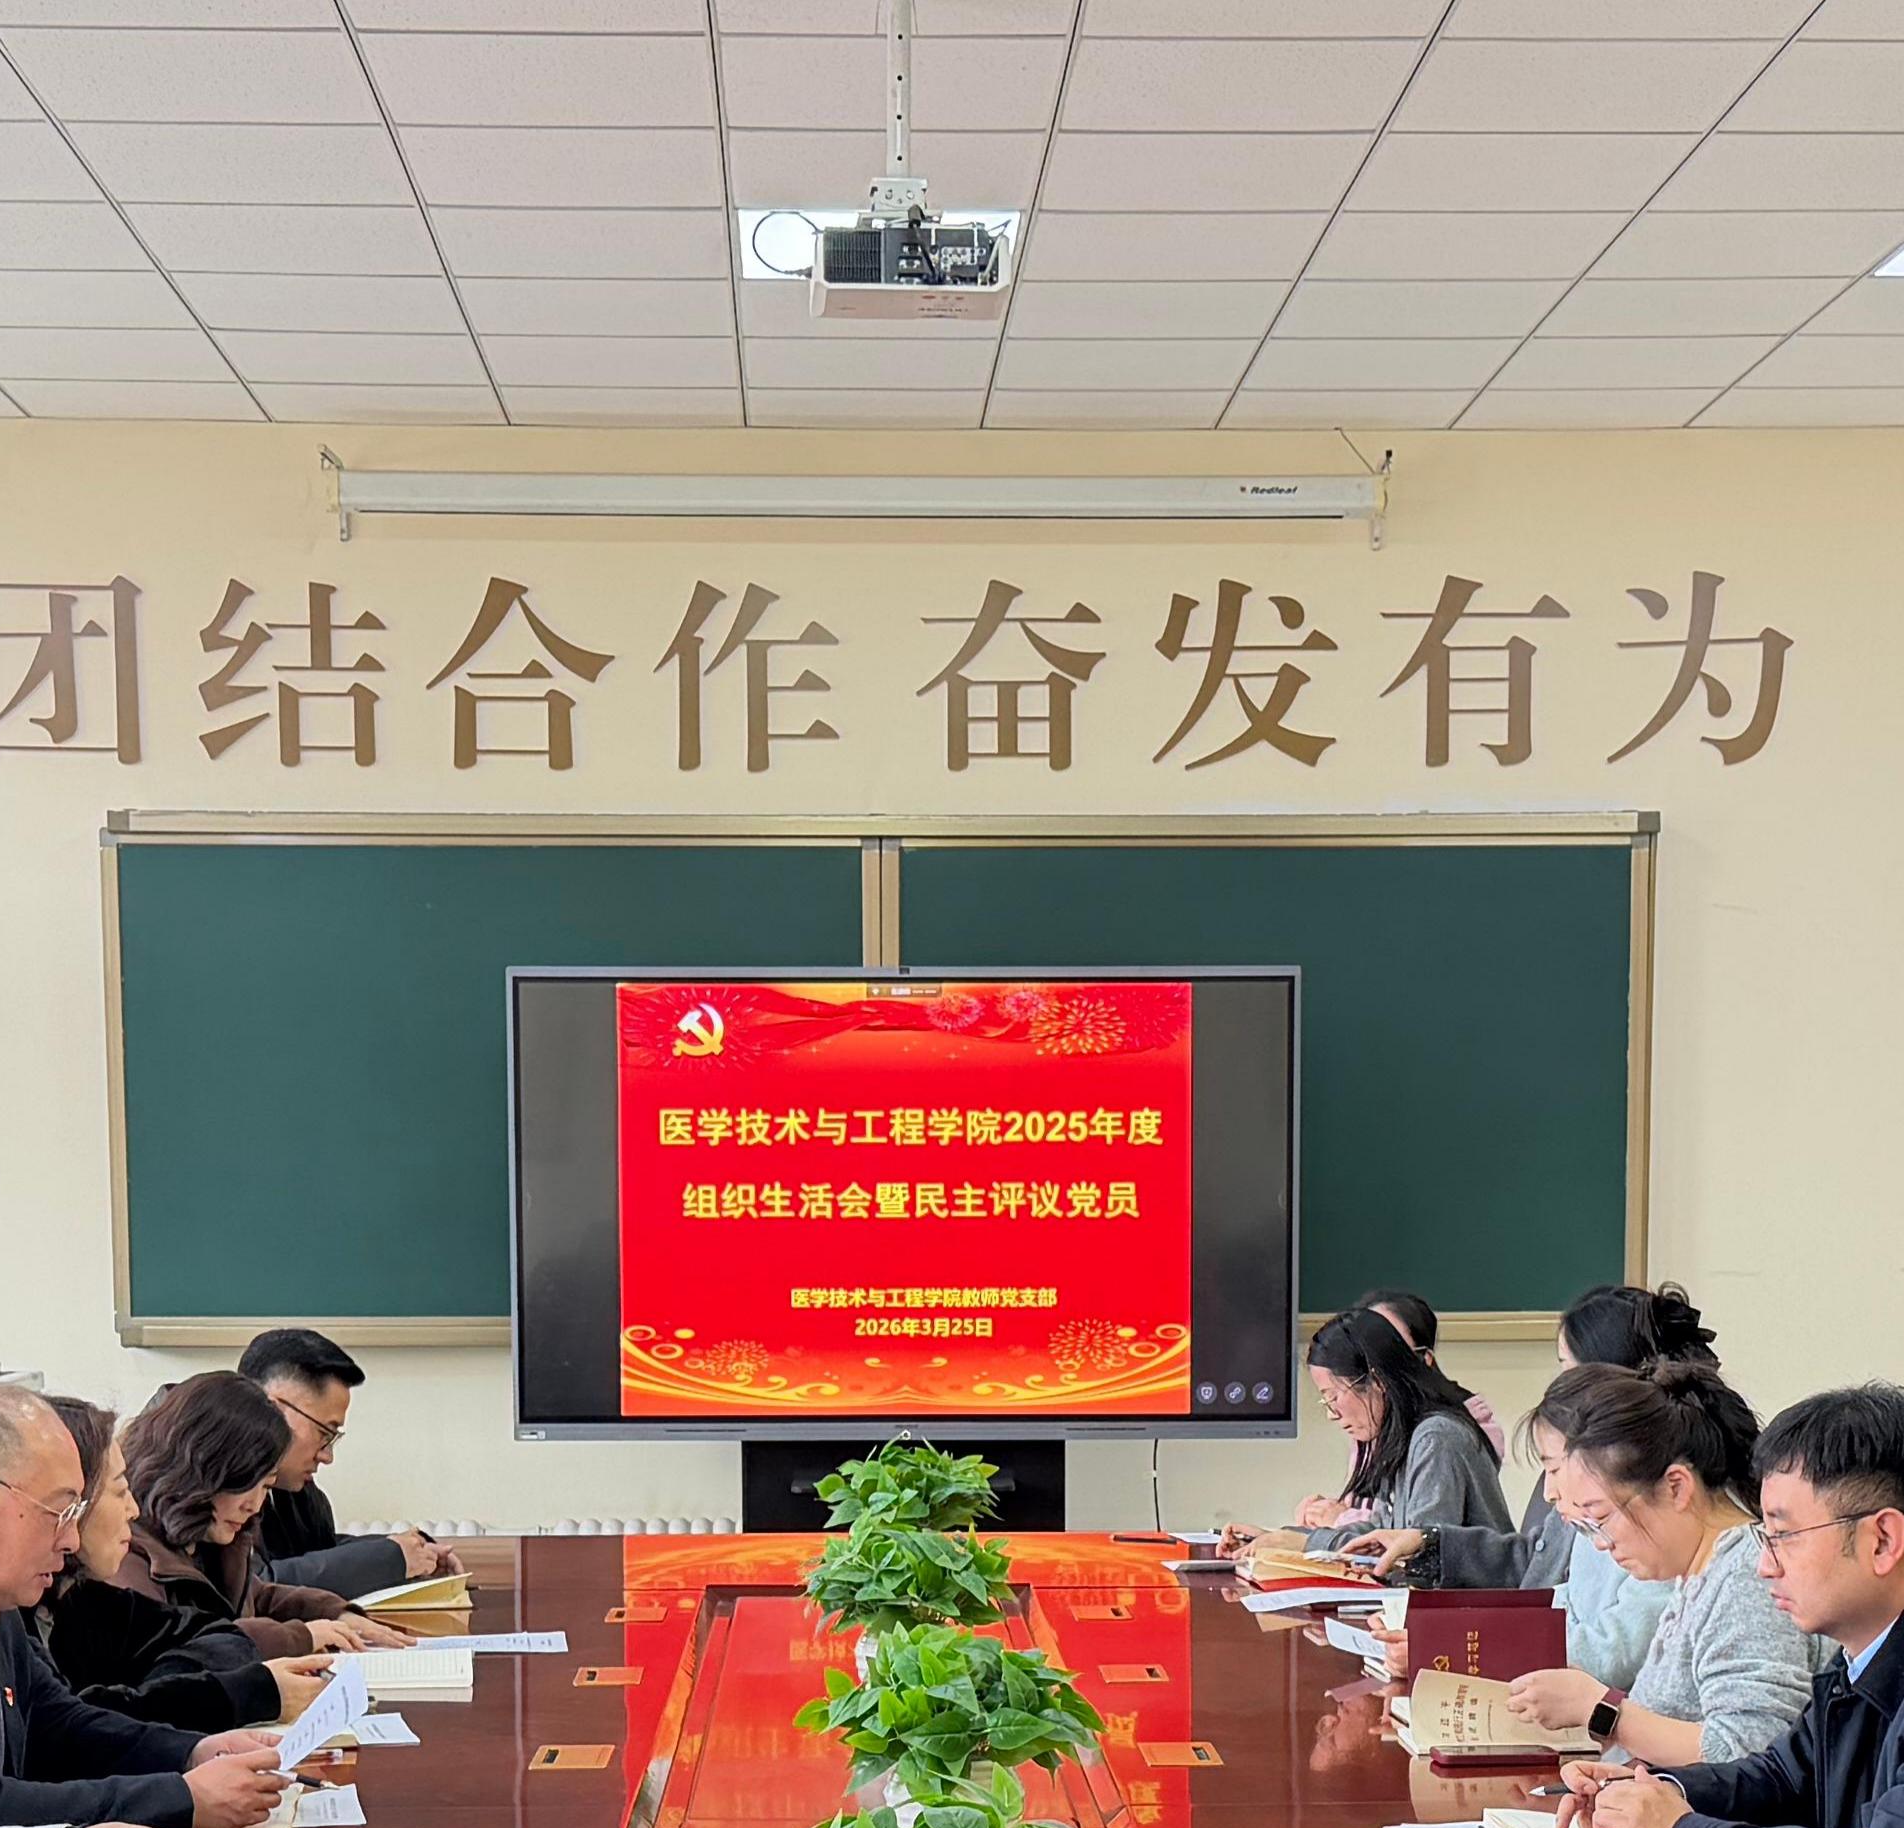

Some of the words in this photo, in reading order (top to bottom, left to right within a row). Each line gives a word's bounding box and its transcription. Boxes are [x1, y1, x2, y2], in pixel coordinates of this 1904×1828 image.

[914, 570, 1796, 773] 奋发有为
[658, 1108, 1164, 1147] 医学技术与工程学院2025年度
[682, 1181, 1140, 1219] 组织生活会暨民主评议党员
[790, 1287, 1058, 1308] 医学技术与工程学院教师党支部
[854, 1317, 994, 1338] 2026年3月25日
